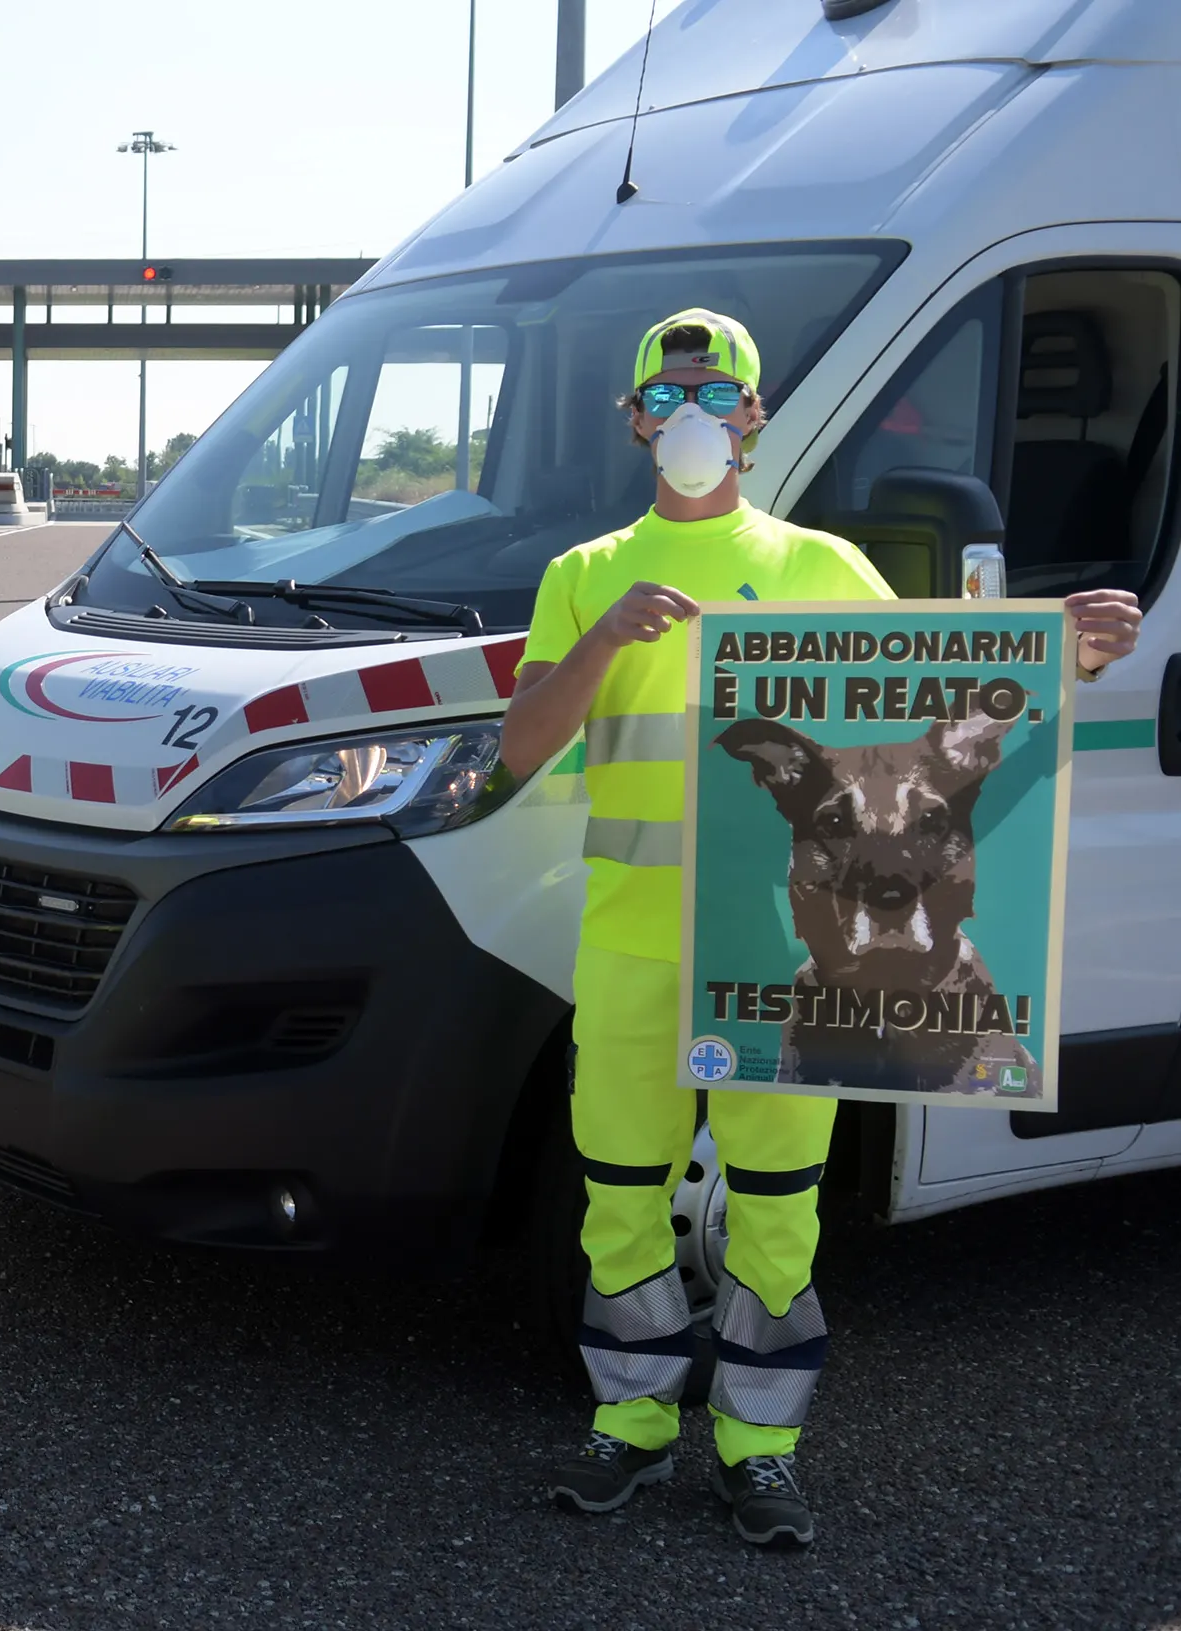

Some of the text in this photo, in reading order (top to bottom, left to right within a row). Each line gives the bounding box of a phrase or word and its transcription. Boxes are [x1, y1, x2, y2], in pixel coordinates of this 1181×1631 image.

[714, 631, 1047, 664] ABBANDONARMI
[80, 660, 200, 682] AUSILIARI
[714, 665, 1044, 723] È UN REATO.
[161, 704, 218, 750] 12
[707, 981, 1032, 1036] TESTIMONIA!
[739, 1045, 762, 1055] Ente
[739, 1055, 785, 1065] Nazionale
[739, 1064, 790, 1075] Protezione
